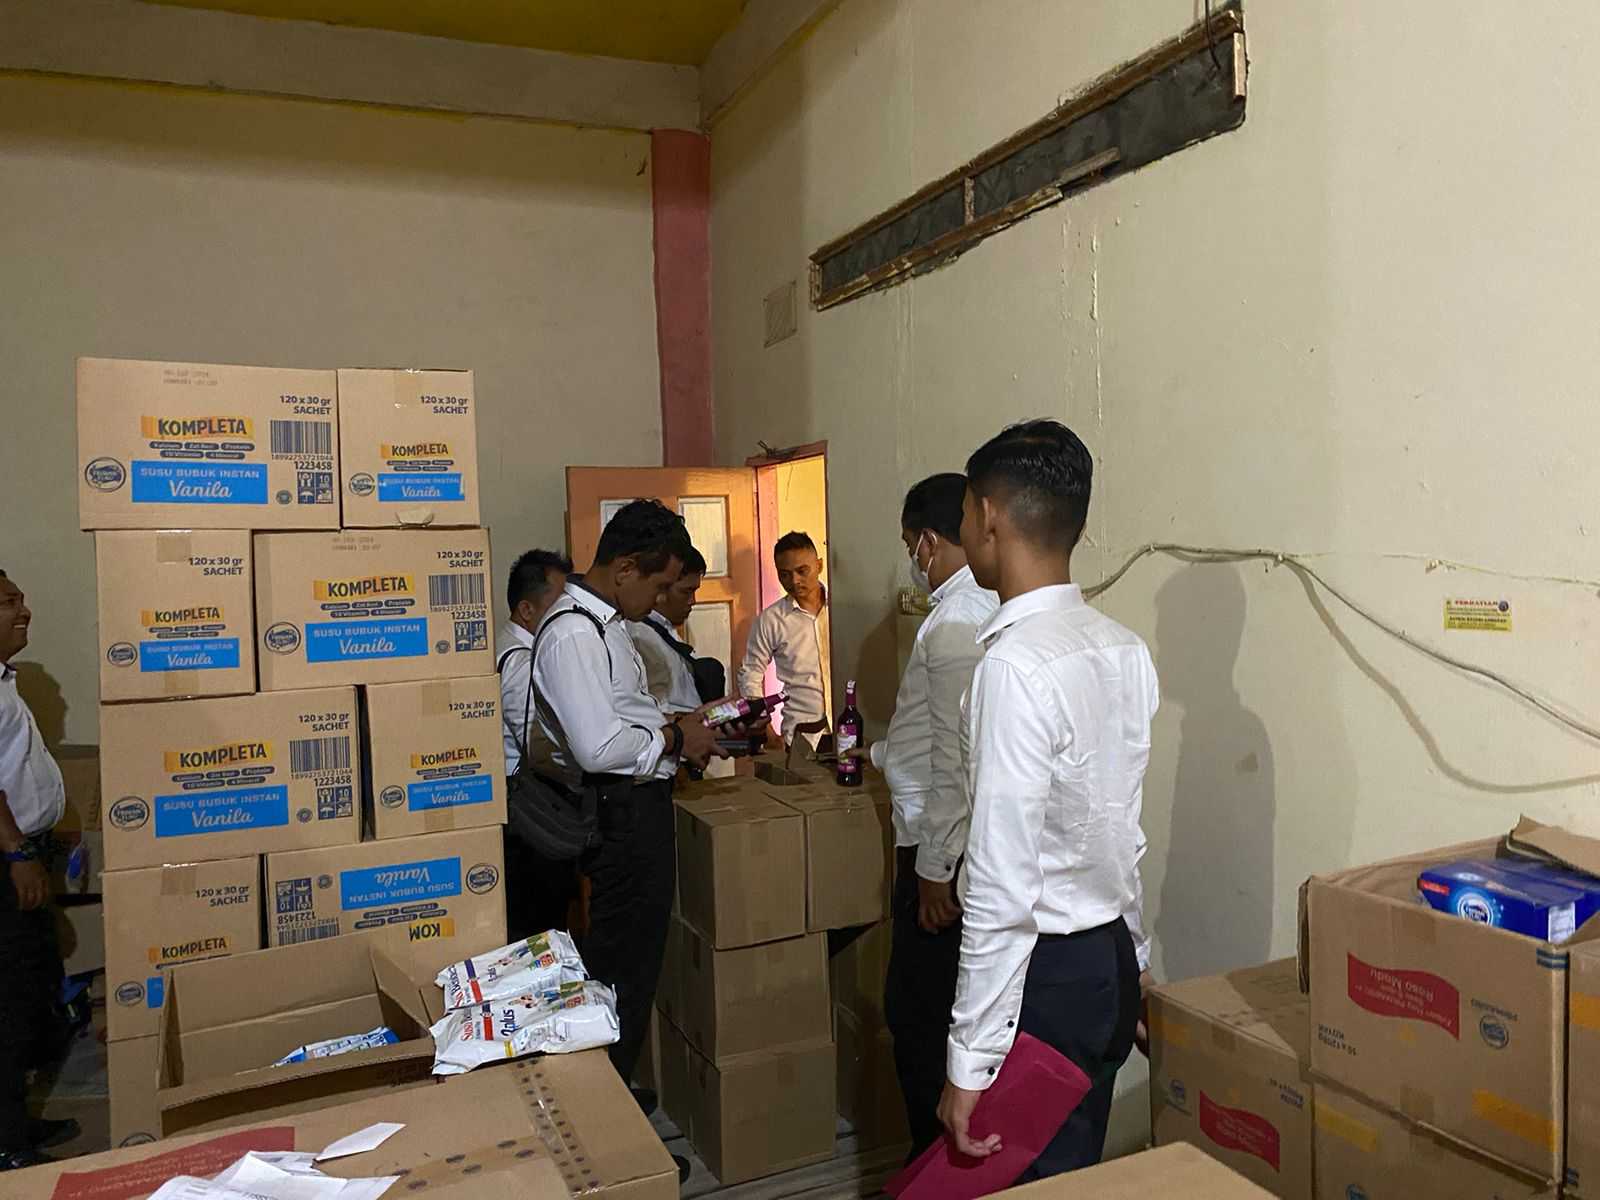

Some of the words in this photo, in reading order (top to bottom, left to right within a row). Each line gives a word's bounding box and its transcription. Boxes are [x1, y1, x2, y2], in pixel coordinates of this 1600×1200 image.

[279, 395, 297, 404] 120
[307, 396, 320, 405] 30
[320, 397, 331, 408] gr
[421, 396, 437, 404] 120
[457, 397, 468, 406] gr
[293, 406, 332, 415] SACHET
[433, 406, 468, 414] SACHET
[158, 418, 247, 436] KOMPLETA
[391, 443, 449, 457] KOMPLETA
[294, 460, 332, 470] 1223458
[140, 467, 171, 477] SUSU
[175, 467, 216, 478] BUBUK
[219, 468, 259, 479] INSTAN
[319, 474, 330, 483] 10
[168, 479, 232, 497] Vanila
[401, 485, 441, 497] Vanila
[437, 551, 452, 559] 120
[473, 551, 483, 560] gr
[188, 557, 207, 565] 120
[217, 557, 230, 565] 30
[231, 557, 243, 567] gr
[449, 559, 484, 568] SACHET
[203, 567, 243, 576] SACHET
[328, 576, 408, 597] KOMPLETA
[155, 607, 220, 623] KOMPLETA
[451, 611, 486, 620] 1223458
[313, 628, 342, 637] SUSU
[344, 626, 381, 635] BUBUK
[384, 624, 420, 633] INSTAN
[338, 637, 397, 655] Vanila
[167, 653, 214, 667] Vanila
[448, 703, 465, 711] 120
[473, 701, 484, 709] 30
[486, 701, 495, 710] gr
[299, 714, 316, 723] 120
[325, 713, 338, 722] 30
[338, 713, 349, 723] gr
[461, 709, 496, 720] SACHET
[312, 722, 349, 732] SACHET
[180, 743, 267, 768] KOMPLETA
[421, 747, 477, 766] KOMPLETA
[313, 775, 351, 787] 1223458
[338, 788, 349, 797] 10
[431, 790, 469, 805] Vanila
[163, 801, 194, 811] SUSU
[198, 797, 237, 808] BUBUK
[240, 793, 280, 803] INSTAN
[191, 808, 254, 828] Vanila
[373, 867, 432, 887] Vanila
[195, 889, 214, 898] 120
[223, 886, 237, 894] 30
[238, 886, 249, 895] gr
[390, 886, 424, 897] BUBUK
[426, 882, 455, 892] SUSU
[209, 895, 249, 907] SACHET
[349, 893, 389, 903] INSTAN
[280, 901, 290, 911] 10
[278, 911, 316, 924] 1223458
[161, 937, 227, 959] KOMPLETA
